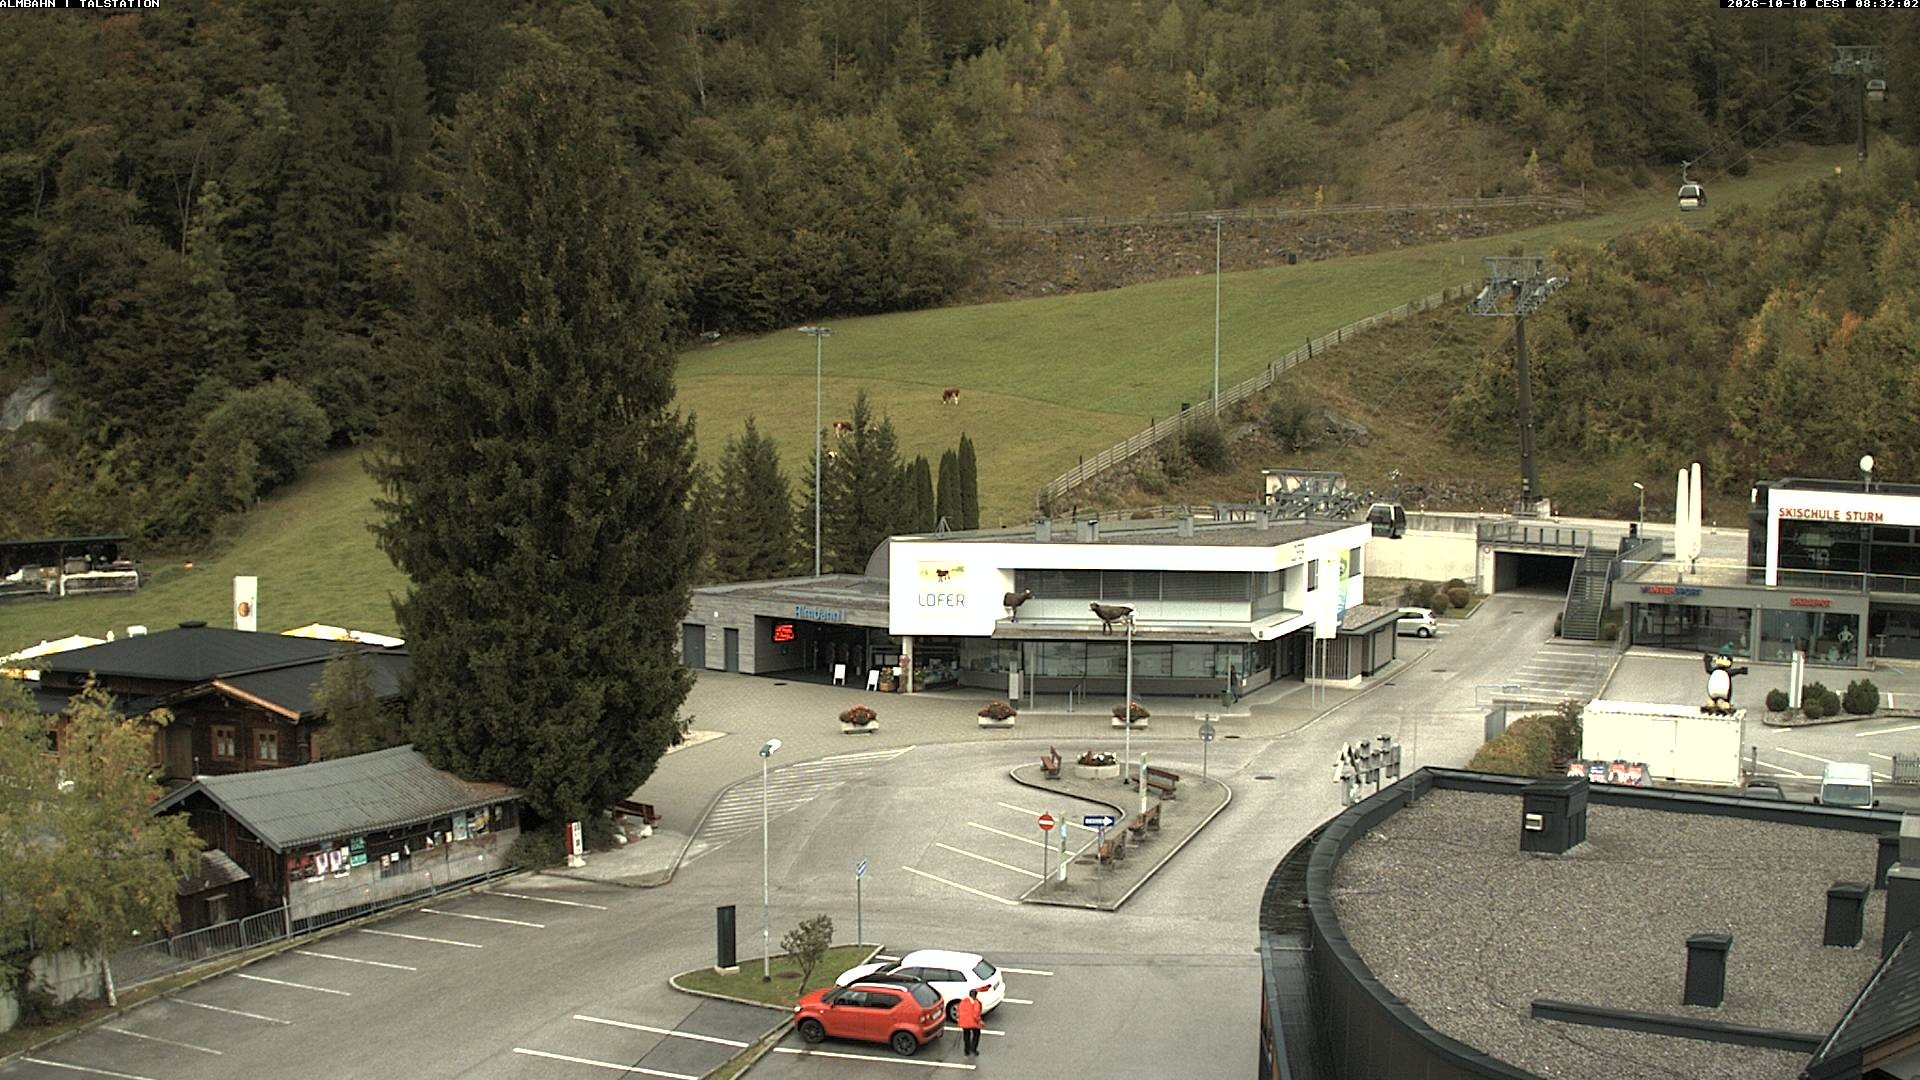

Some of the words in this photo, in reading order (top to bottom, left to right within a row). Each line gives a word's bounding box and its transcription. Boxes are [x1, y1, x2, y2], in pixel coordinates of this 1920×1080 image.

[1779, 507, 1840, 520] SKISCHULE
[1846, 510, 1884, 522] STURM
[918, 593, 966, 607] LOFER
